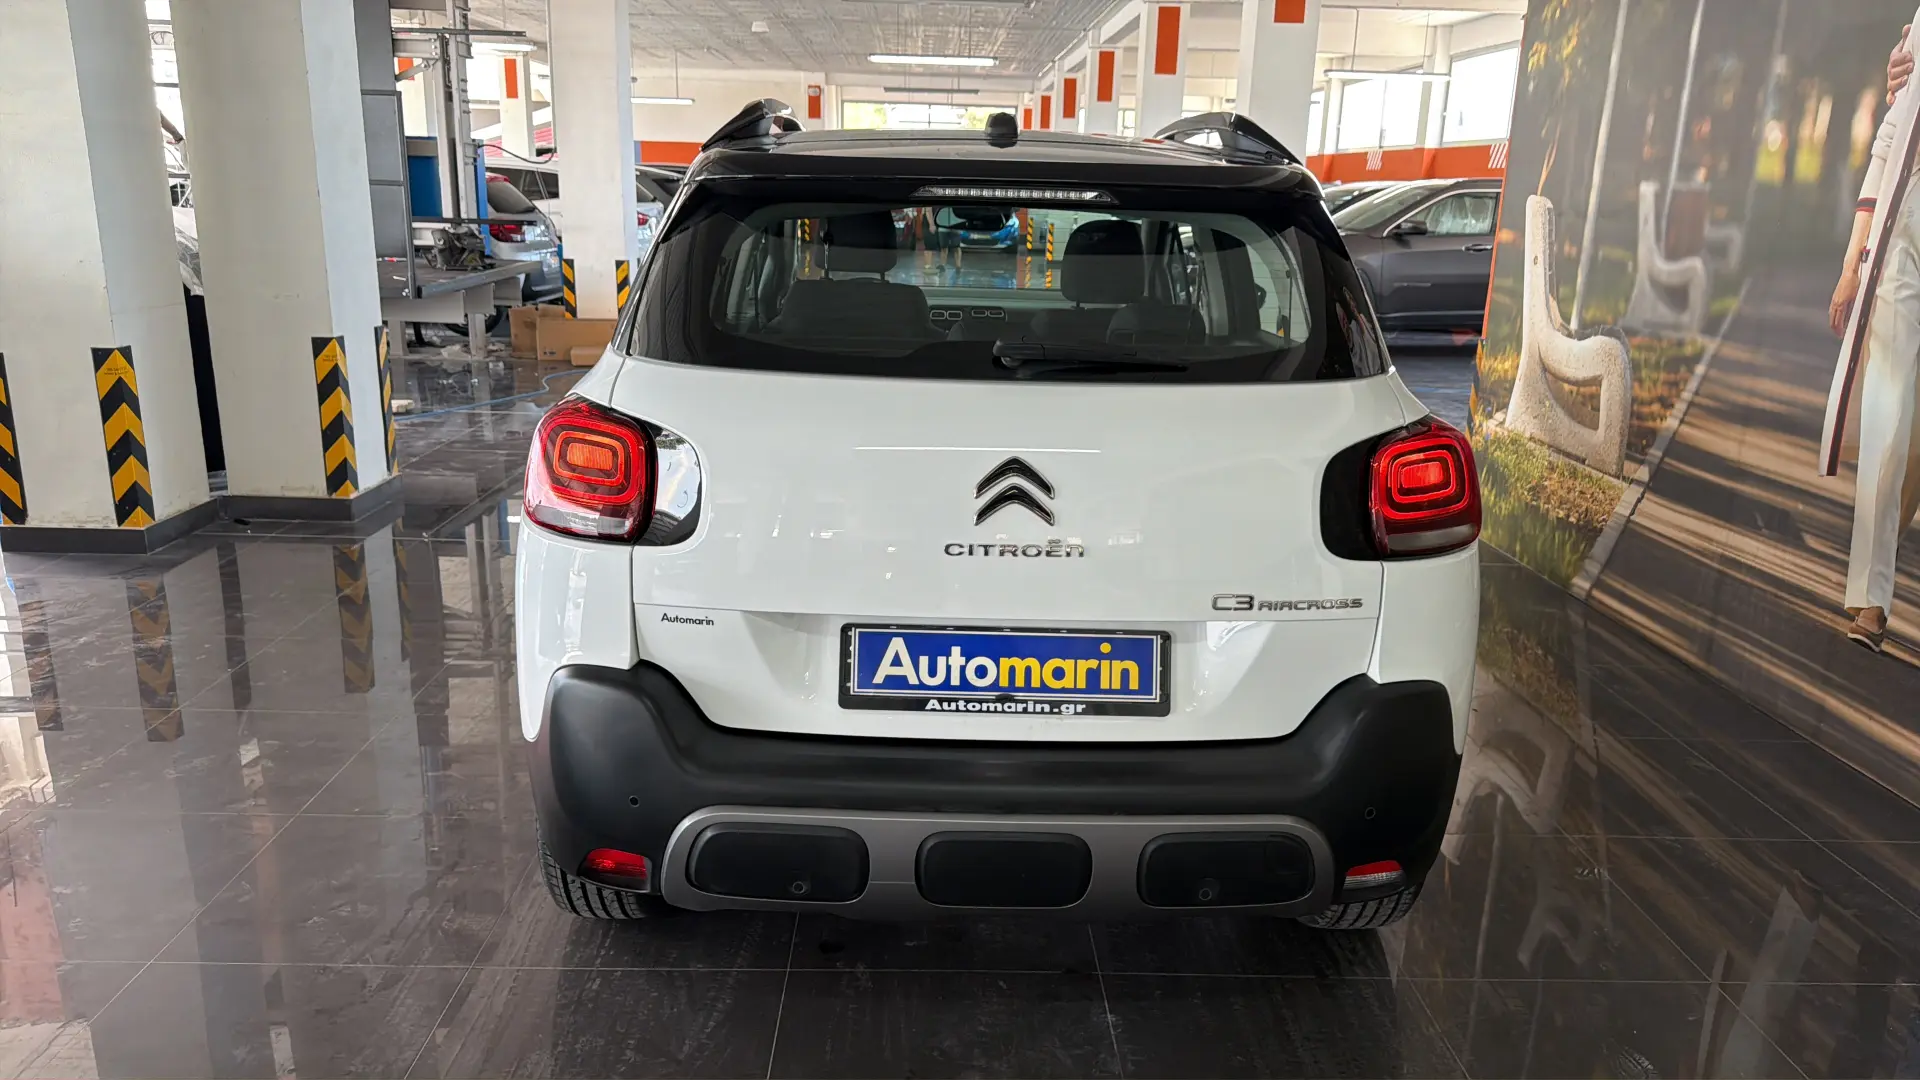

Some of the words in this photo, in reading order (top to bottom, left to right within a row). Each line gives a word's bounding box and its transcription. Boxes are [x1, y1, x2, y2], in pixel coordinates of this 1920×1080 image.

[1211, 593, 1255, 611] C3
[1257, 598, 1364, 612] AIRCROSS
[660, 612, 715, 626] Automarin
[871, 636, 1140, 690] Automarin
[924, 699, 1087, 716] Automarin.gr
